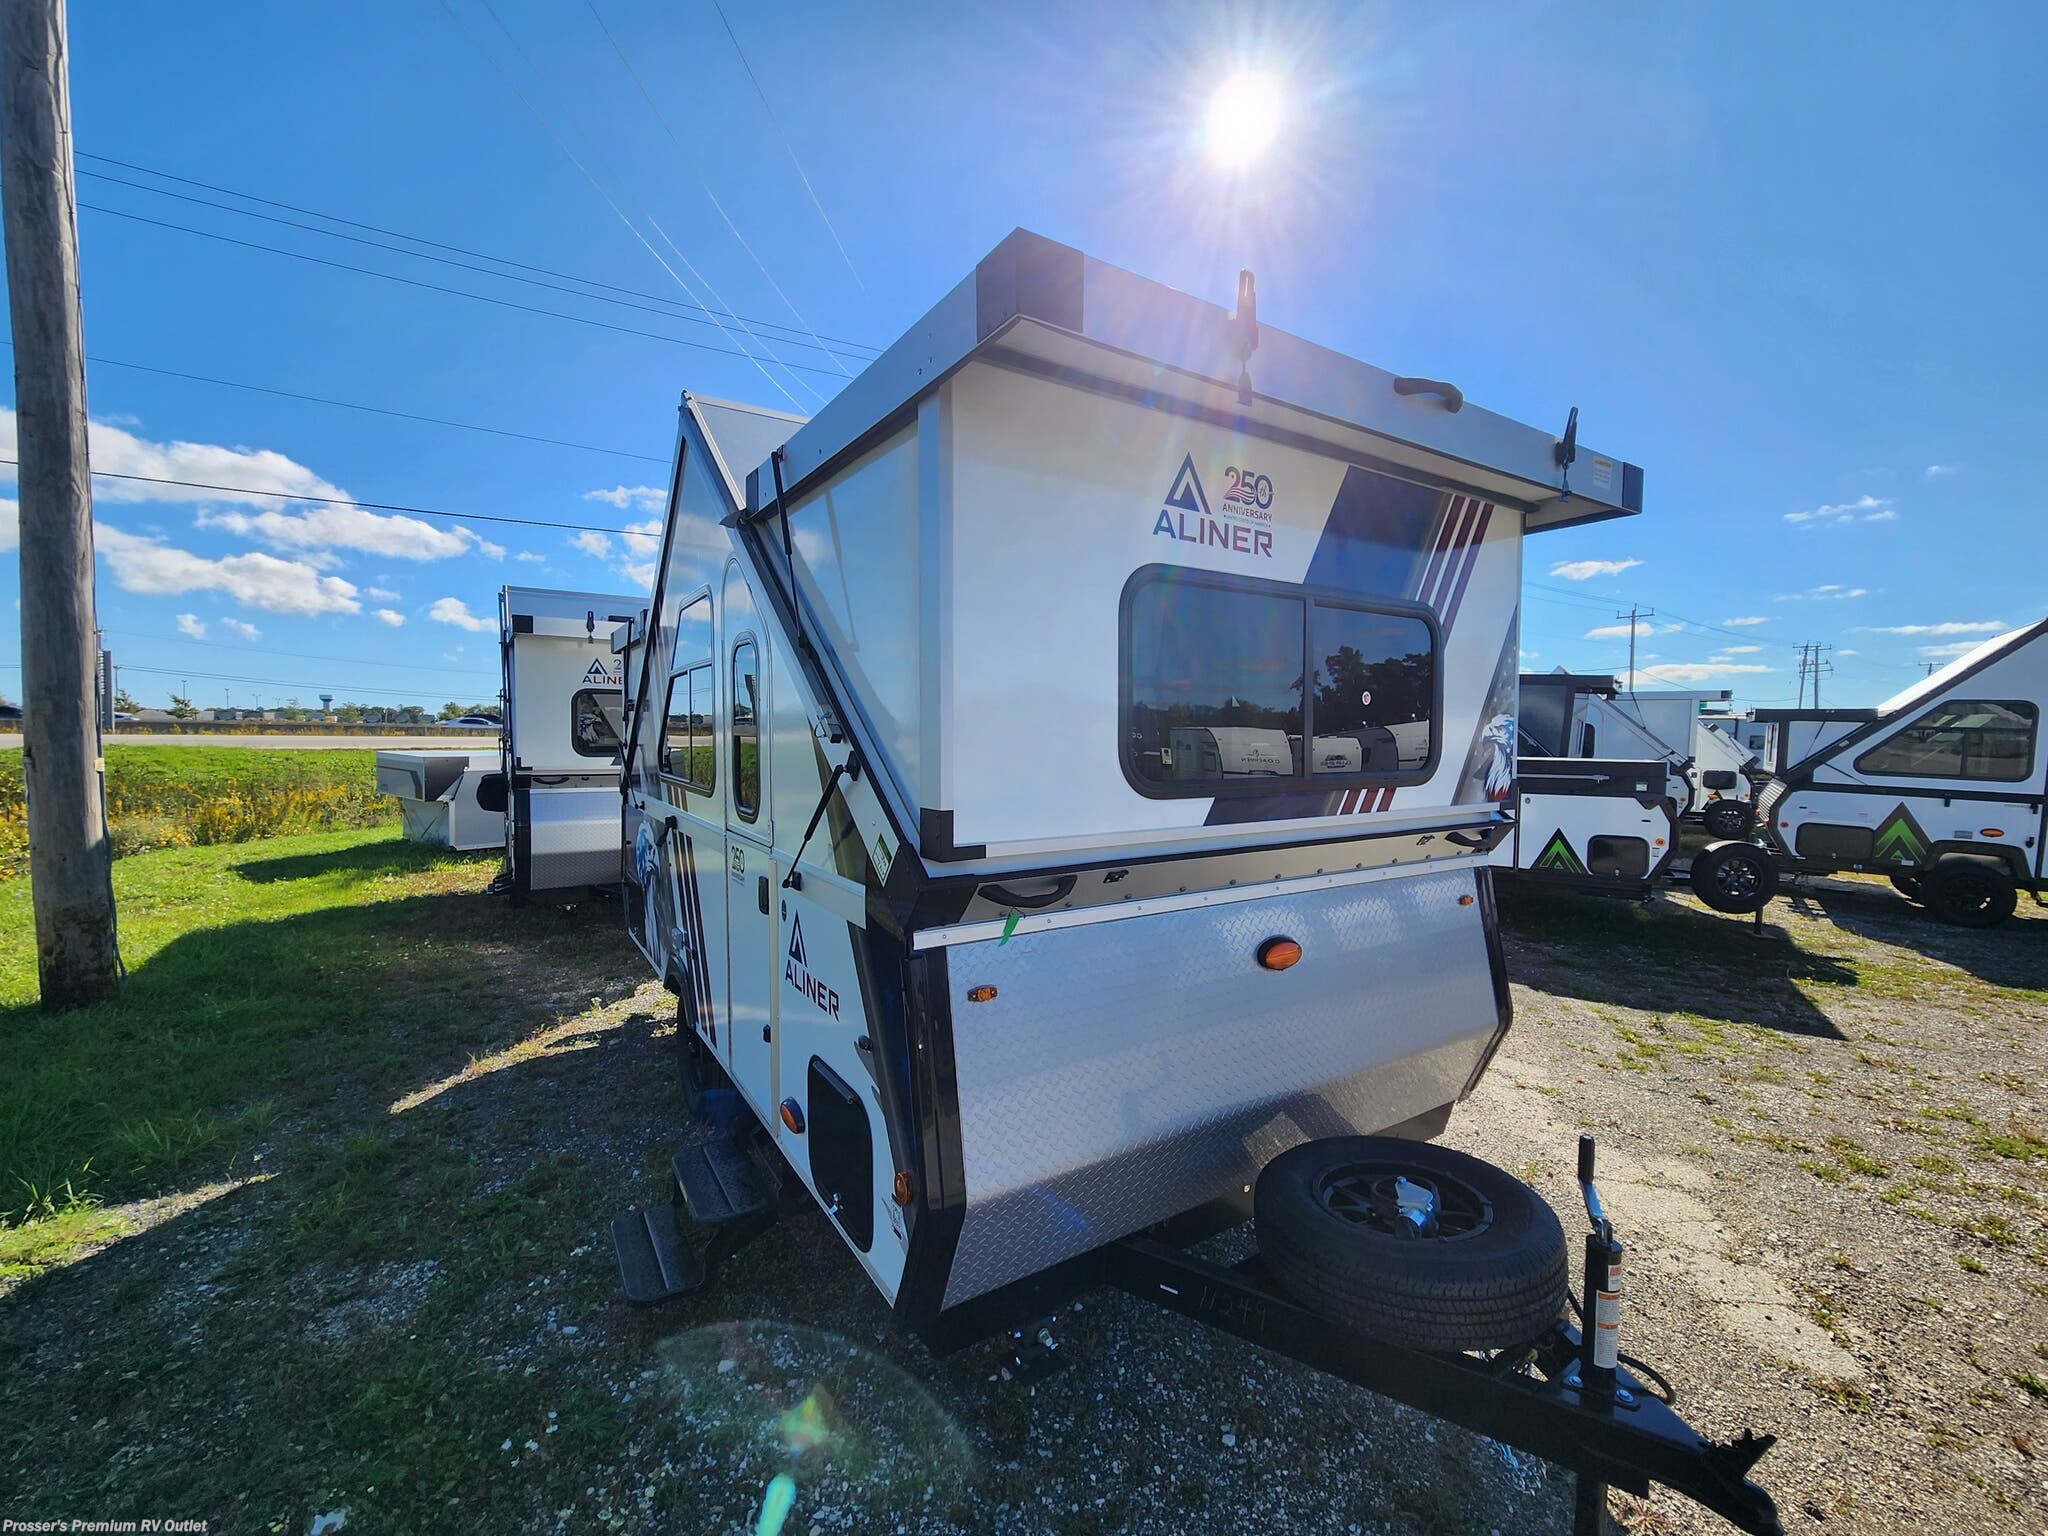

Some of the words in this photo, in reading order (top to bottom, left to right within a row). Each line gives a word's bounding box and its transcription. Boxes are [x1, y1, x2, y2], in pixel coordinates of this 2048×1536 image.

[1224, 466, 1273, 510] 250
[1152, 509, 1273, 559] ALINER
[1222, 503, 1273, 522] ANNIVERSARY
[582, 675, 623, 685] ALINE
[785, 959, 840, 1023] ALINER
